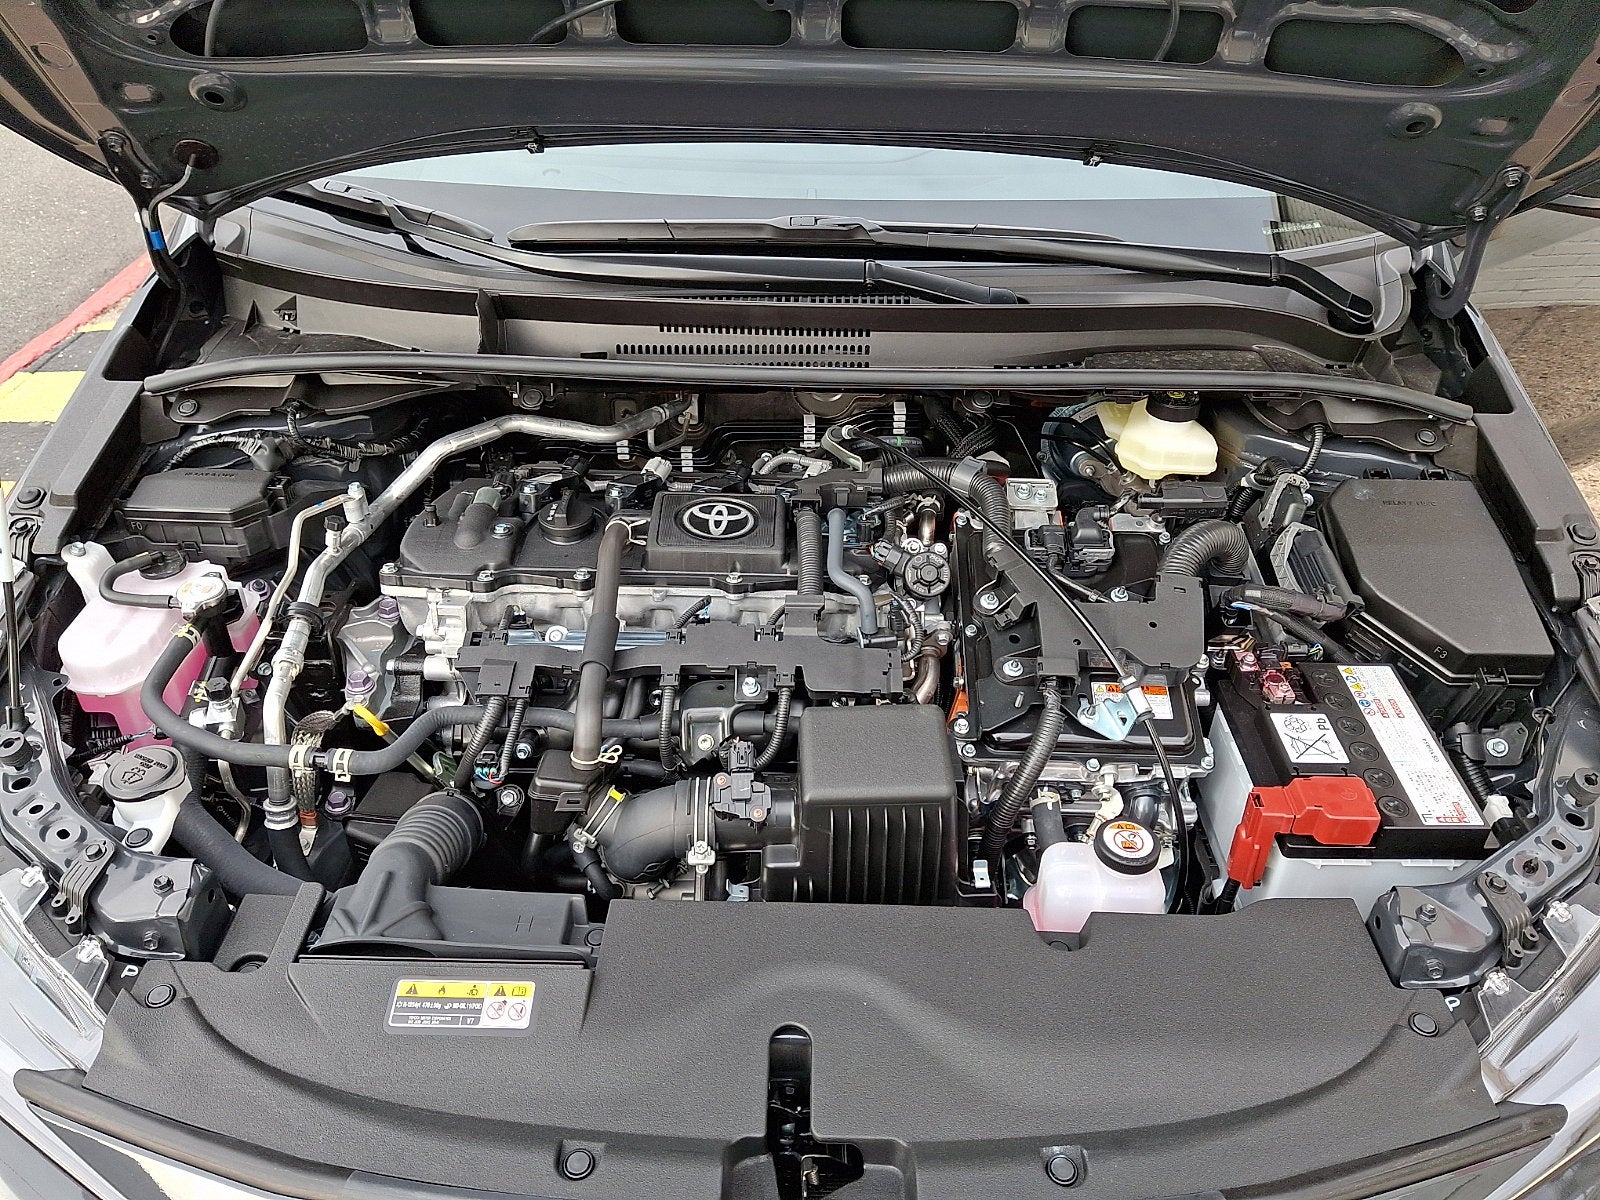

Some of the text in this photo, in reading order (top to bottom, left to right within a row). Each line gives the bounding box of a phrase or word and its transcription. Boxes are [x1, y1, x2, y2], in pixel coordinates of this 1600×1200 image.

[1433, 645, 1448, 659] F3
[1317, 717, 1330, 731] Pb
[120, 964, 139, 978] P
[1444, 996, 1461, 1012] P
